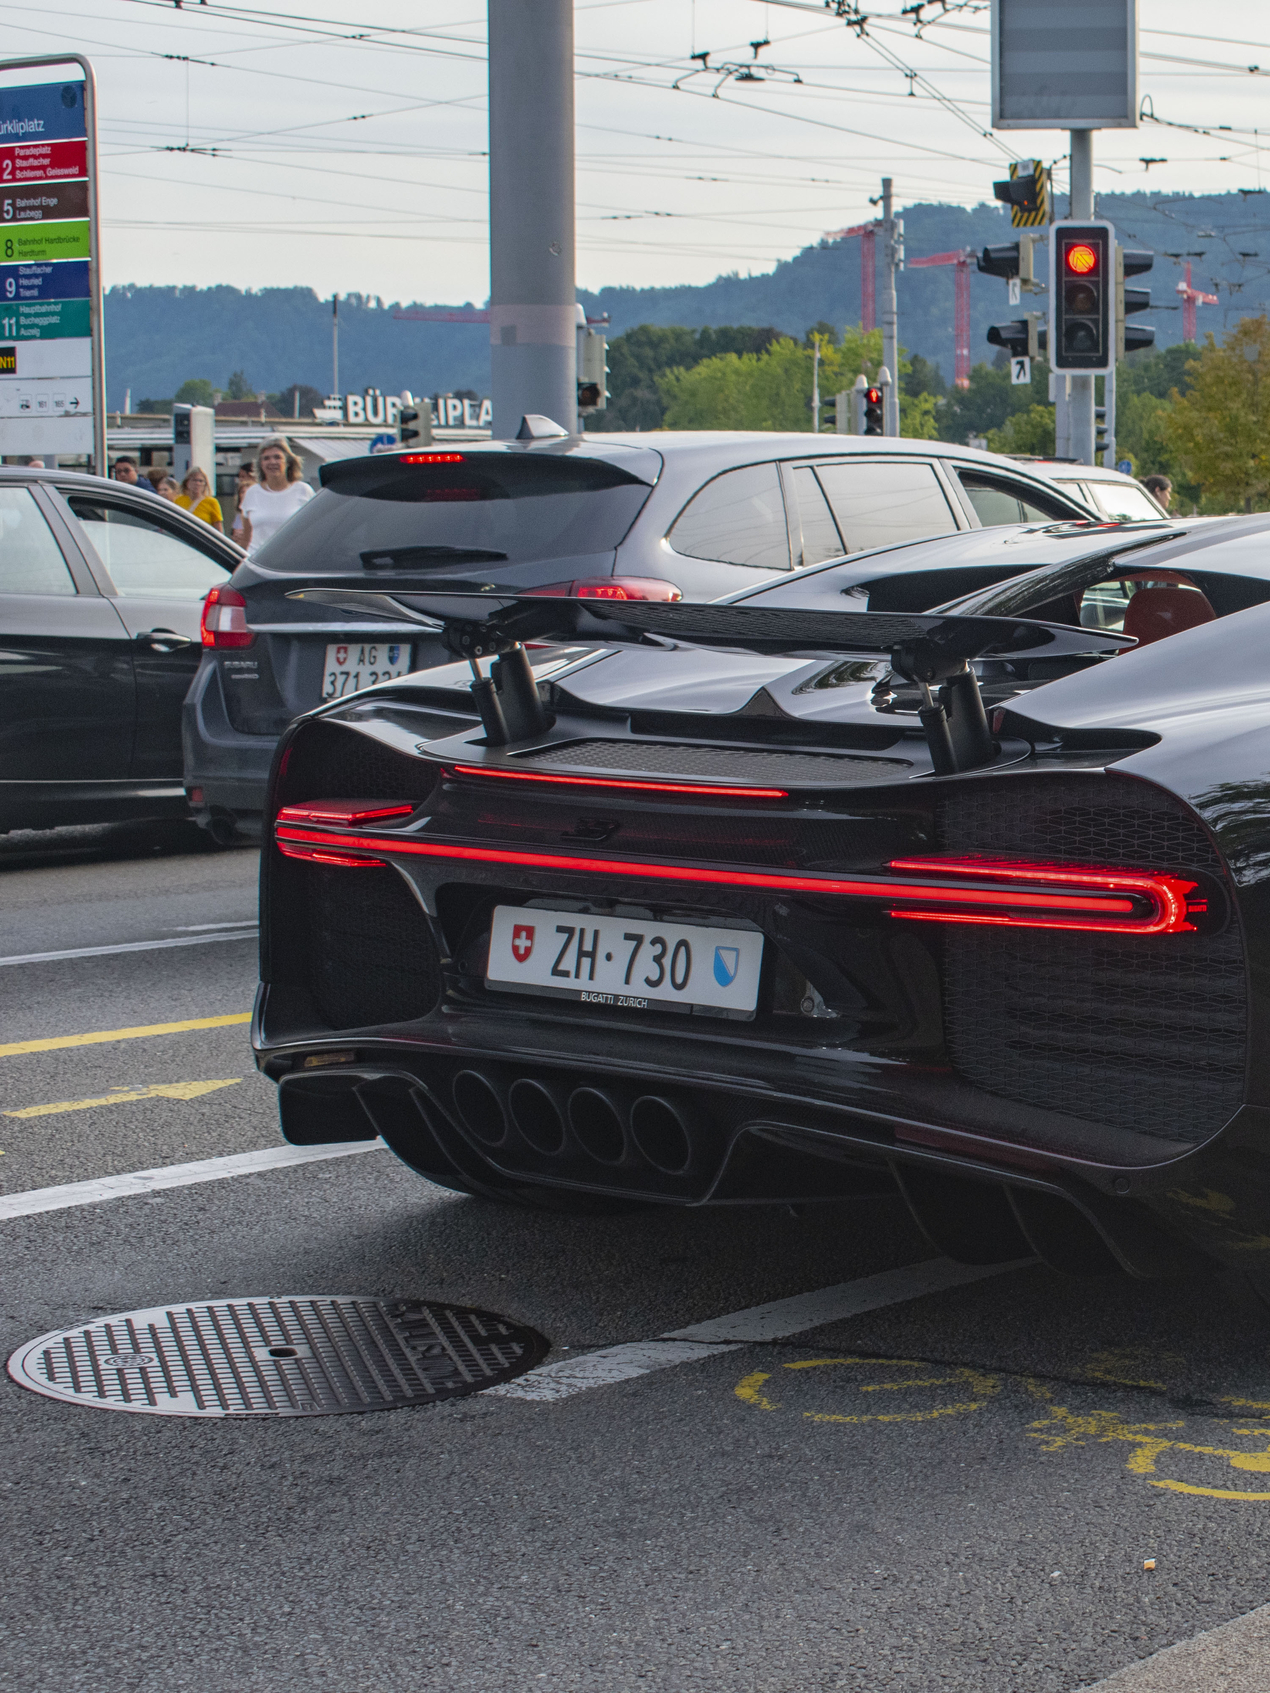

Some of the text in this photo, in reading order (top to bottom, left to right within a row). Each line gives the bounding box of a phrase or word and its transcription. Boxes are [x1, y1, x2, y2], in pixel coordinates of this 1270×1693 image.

[15, 146, 51, 156] Paradeplatz
[15, 158, 51, 168] Stauffacher
[3, 160, 13, 180] 2
[15, 166, 79, 179] Schlieren, Geissweid
[16, 196, 58, 207] Bahnhof Enge
[3, 199, 13, 219] 5
[16, 209, 42, 219] Laubegg
[18, 235, 80, 247] Bahnhof Hardbrücke
[5, 239, 14, 258] 8
[18, 249, 47, 257] Hardturm
[19, 265, 53, 275] Stauffacher
[19, 277, 42, 286] Heuried
[6, 278, 16, 298] 9
[19, 288, 39, 297] Triemli
[19, 303, 62, 314] Hauptbahnhof
[20, 315, 60, 326] Bucheggplatz
[2, 317, 17, 337] 11
[20, 327, 40, 337] Auzelg
[0, 356, 15, 369] N11
[358, 645, 378, 666] AG
[580, 991, 648, 1008] BUGATTI ZURICH
